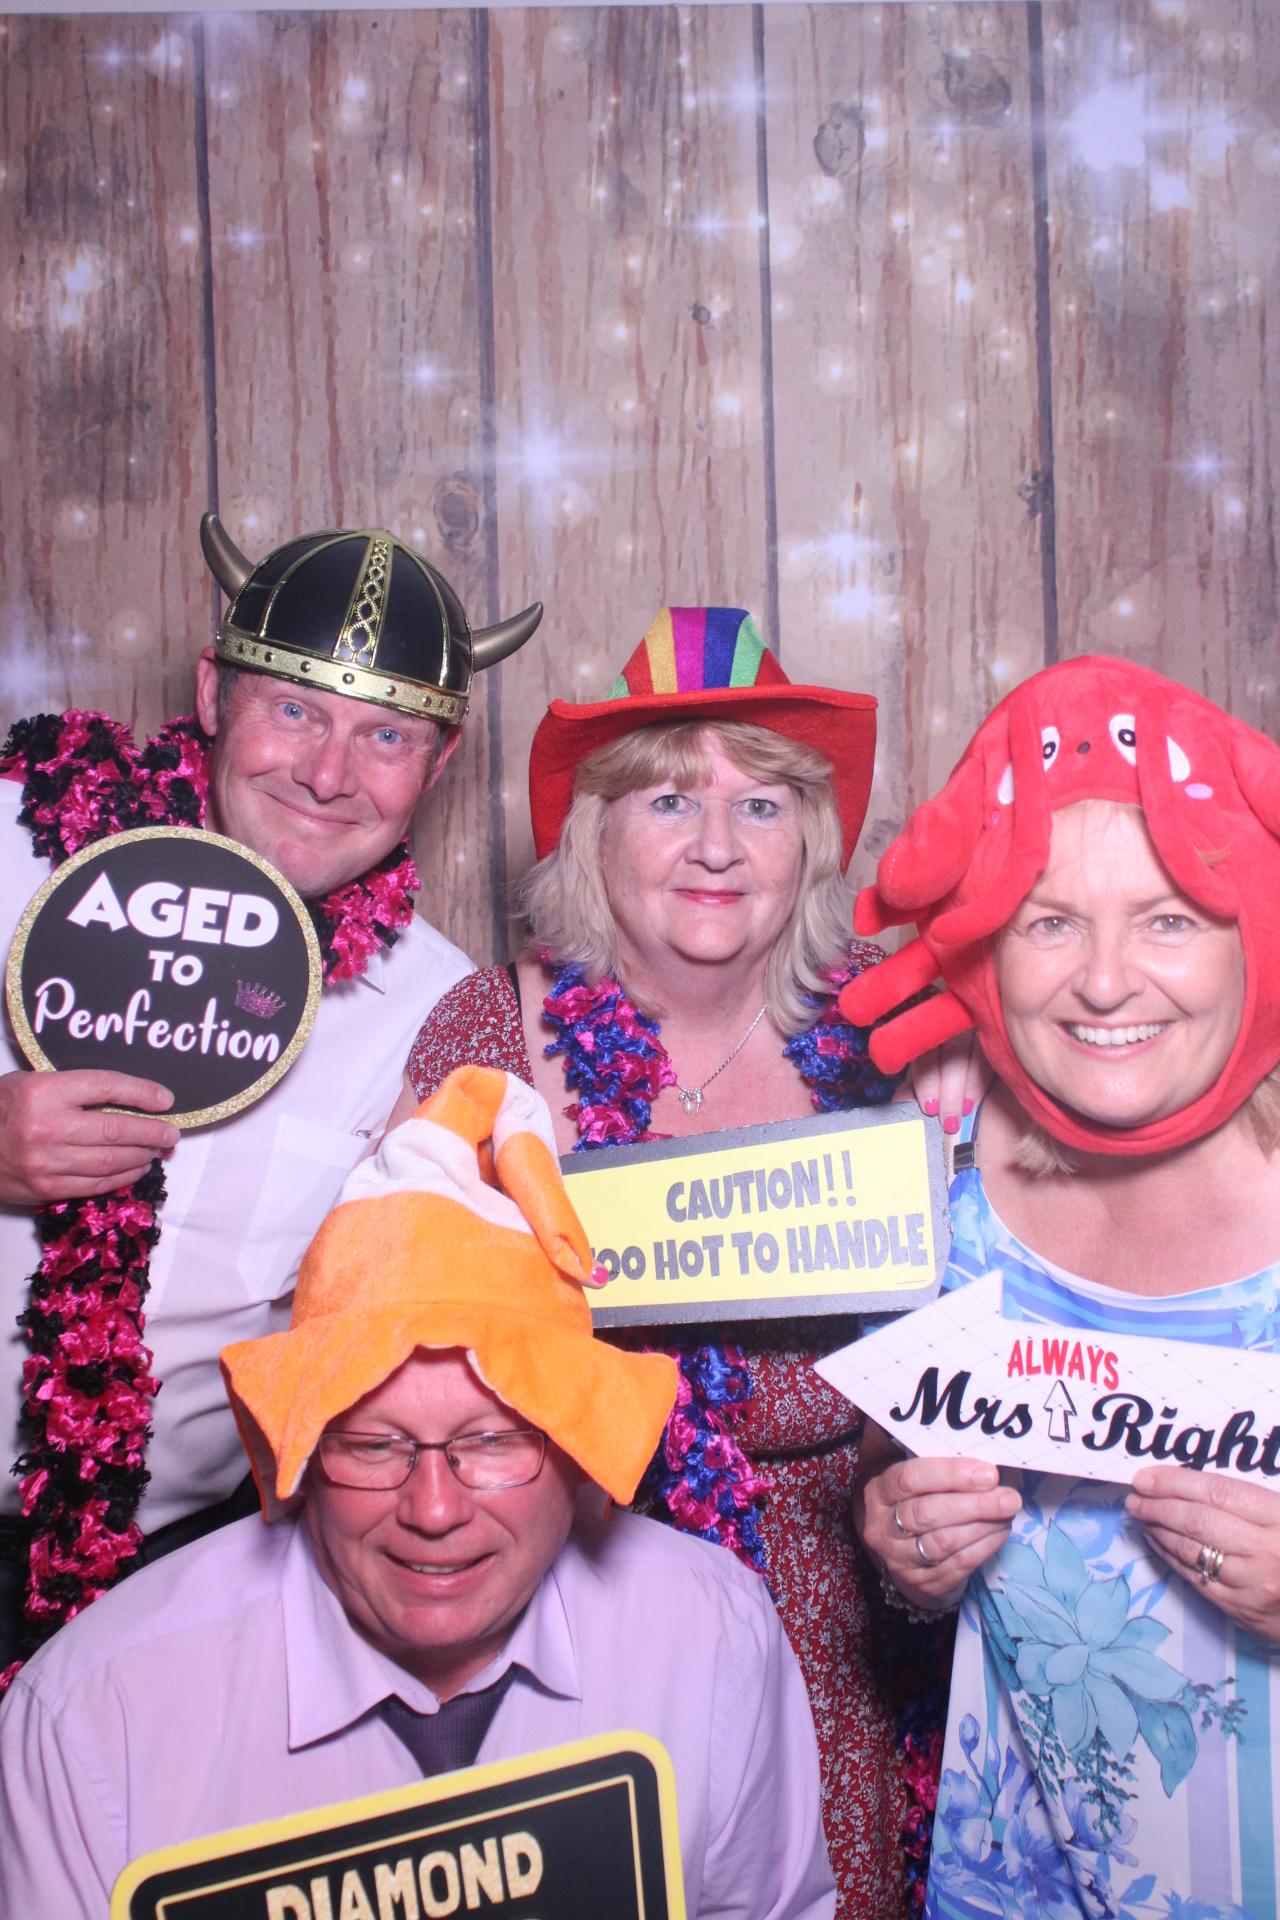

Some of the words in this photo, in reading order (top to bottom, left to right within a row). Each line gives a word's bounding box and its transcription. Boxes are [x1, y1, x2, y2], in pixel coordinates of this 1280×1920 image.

[66, 870, 279, 947] AGED
[149, 950, 203, 986] TO
[35, 977, 280, 1062] Perfection
[666, 1150, 857, 1222] CAUTION!!
[590, 1247, 646, 1282] OO
[653, 1234, 724, 1281] HOT
[731, 1231, 780, 1275] TO
[786, 1213, 929, 1274] HANDLE
[1007, 1339, 1120, 1391] ALWAYS
[890, 1366, 1033, 1438] Mrs
